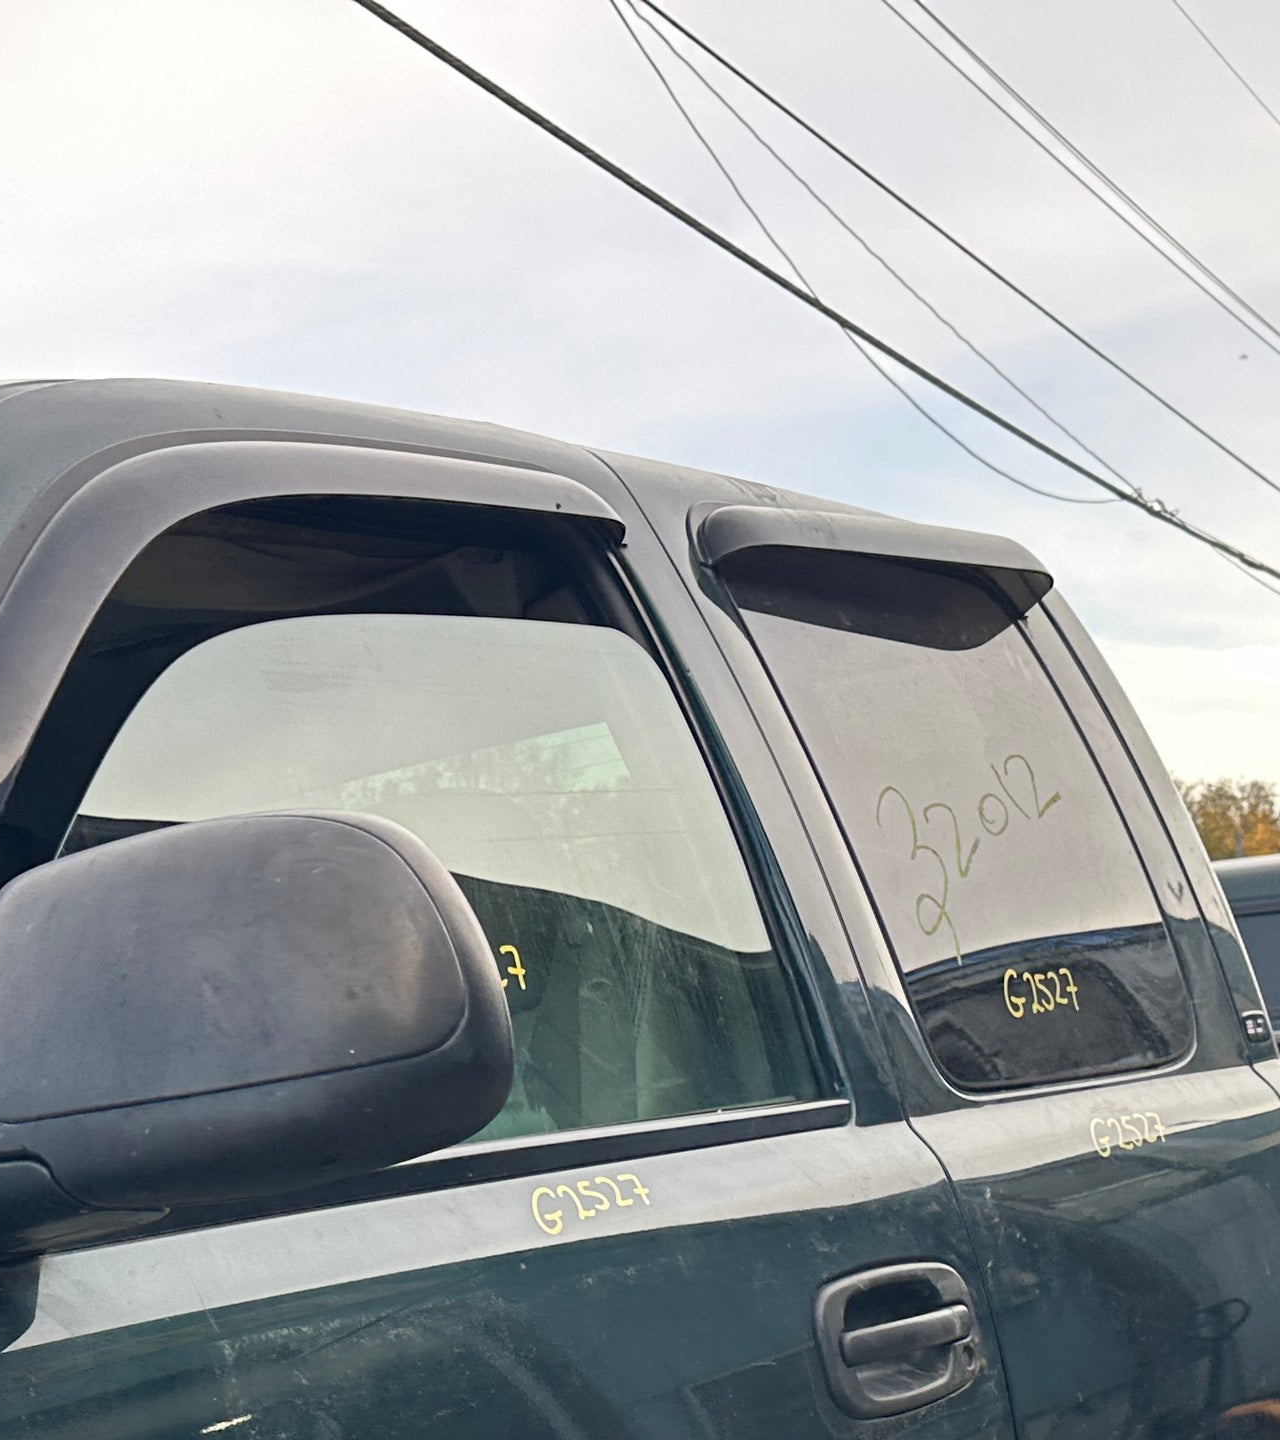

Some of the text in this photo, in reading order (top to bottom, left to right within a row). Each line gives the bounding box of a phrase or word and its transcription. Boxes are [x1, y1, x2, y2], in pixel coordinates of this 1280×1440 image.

[1004, 967, 1079, 1018] G2527
[1090, 1112, 1166, 1158] G2527
[531, 1173, 650, 1236] G2527
